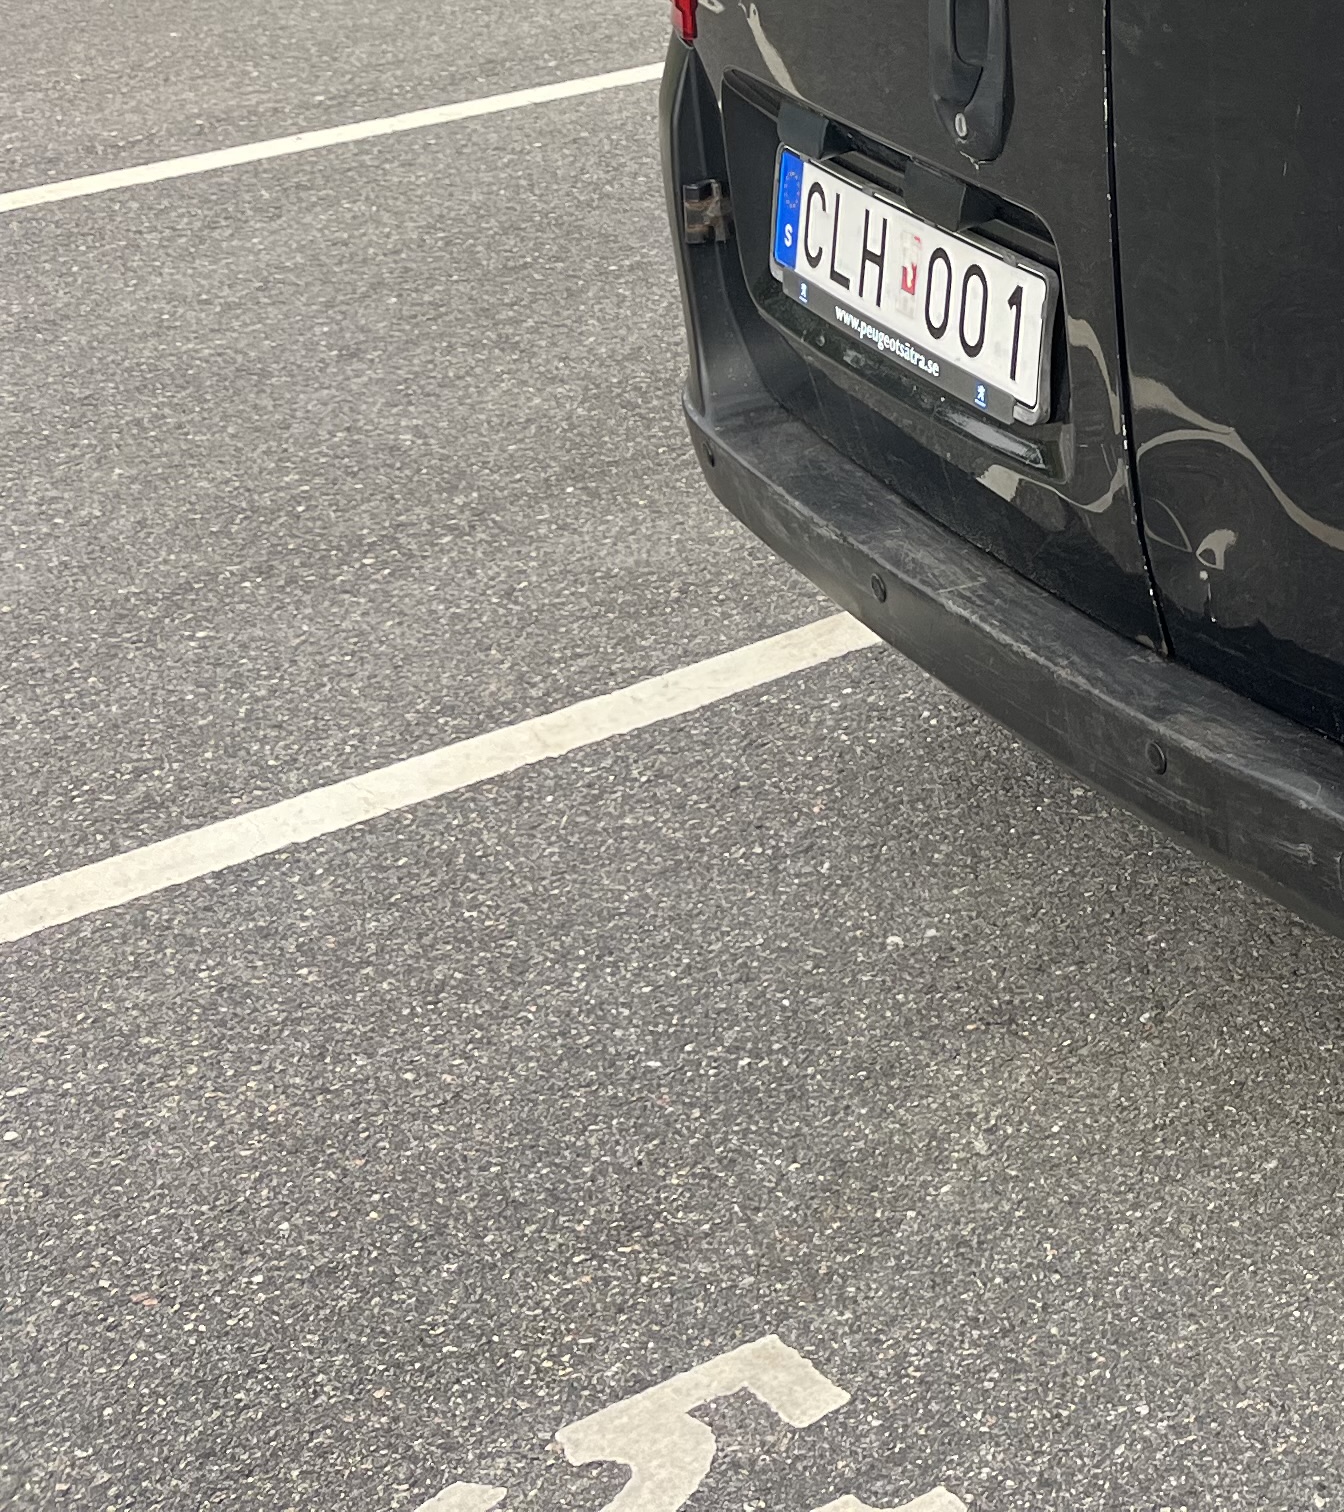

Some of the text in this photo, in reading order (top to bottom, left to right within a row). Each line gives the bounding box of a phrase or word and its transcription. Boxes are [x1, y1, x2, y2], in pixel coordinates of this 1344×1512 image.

[784, 223, 793, 248] S
[804, 181, 1024, 381] CLH 001
